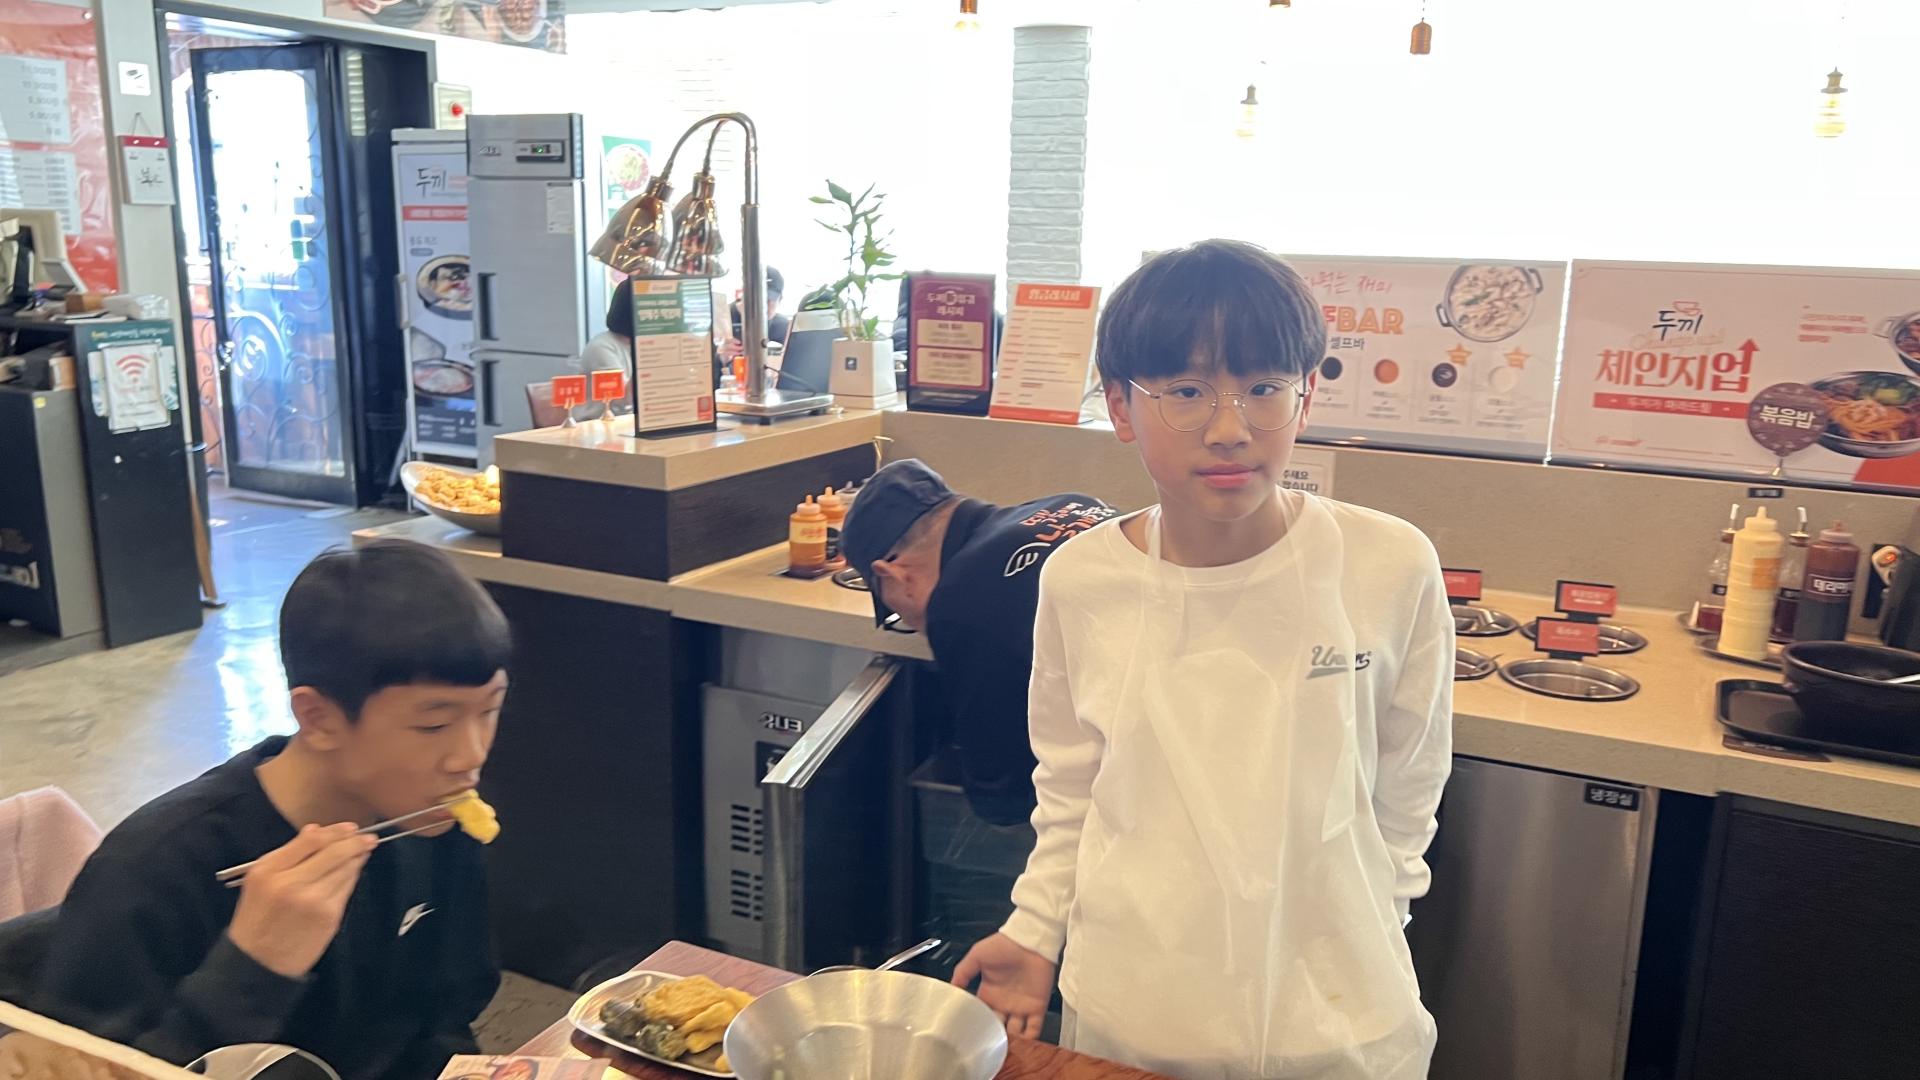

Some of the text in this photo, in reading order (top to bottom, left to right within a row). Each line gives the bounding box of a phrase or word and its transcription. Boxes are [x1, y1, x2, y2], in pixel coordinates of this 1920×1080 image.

[416, 168, 447, 199] 두끼
[1652, 310, 1704, 342] 두끼
[1595, 341, 1757, 393] 체인지업
[1759, 405, 1817, 430] 볶음밥
[1590, 787, 1634, 807] 냉장실
